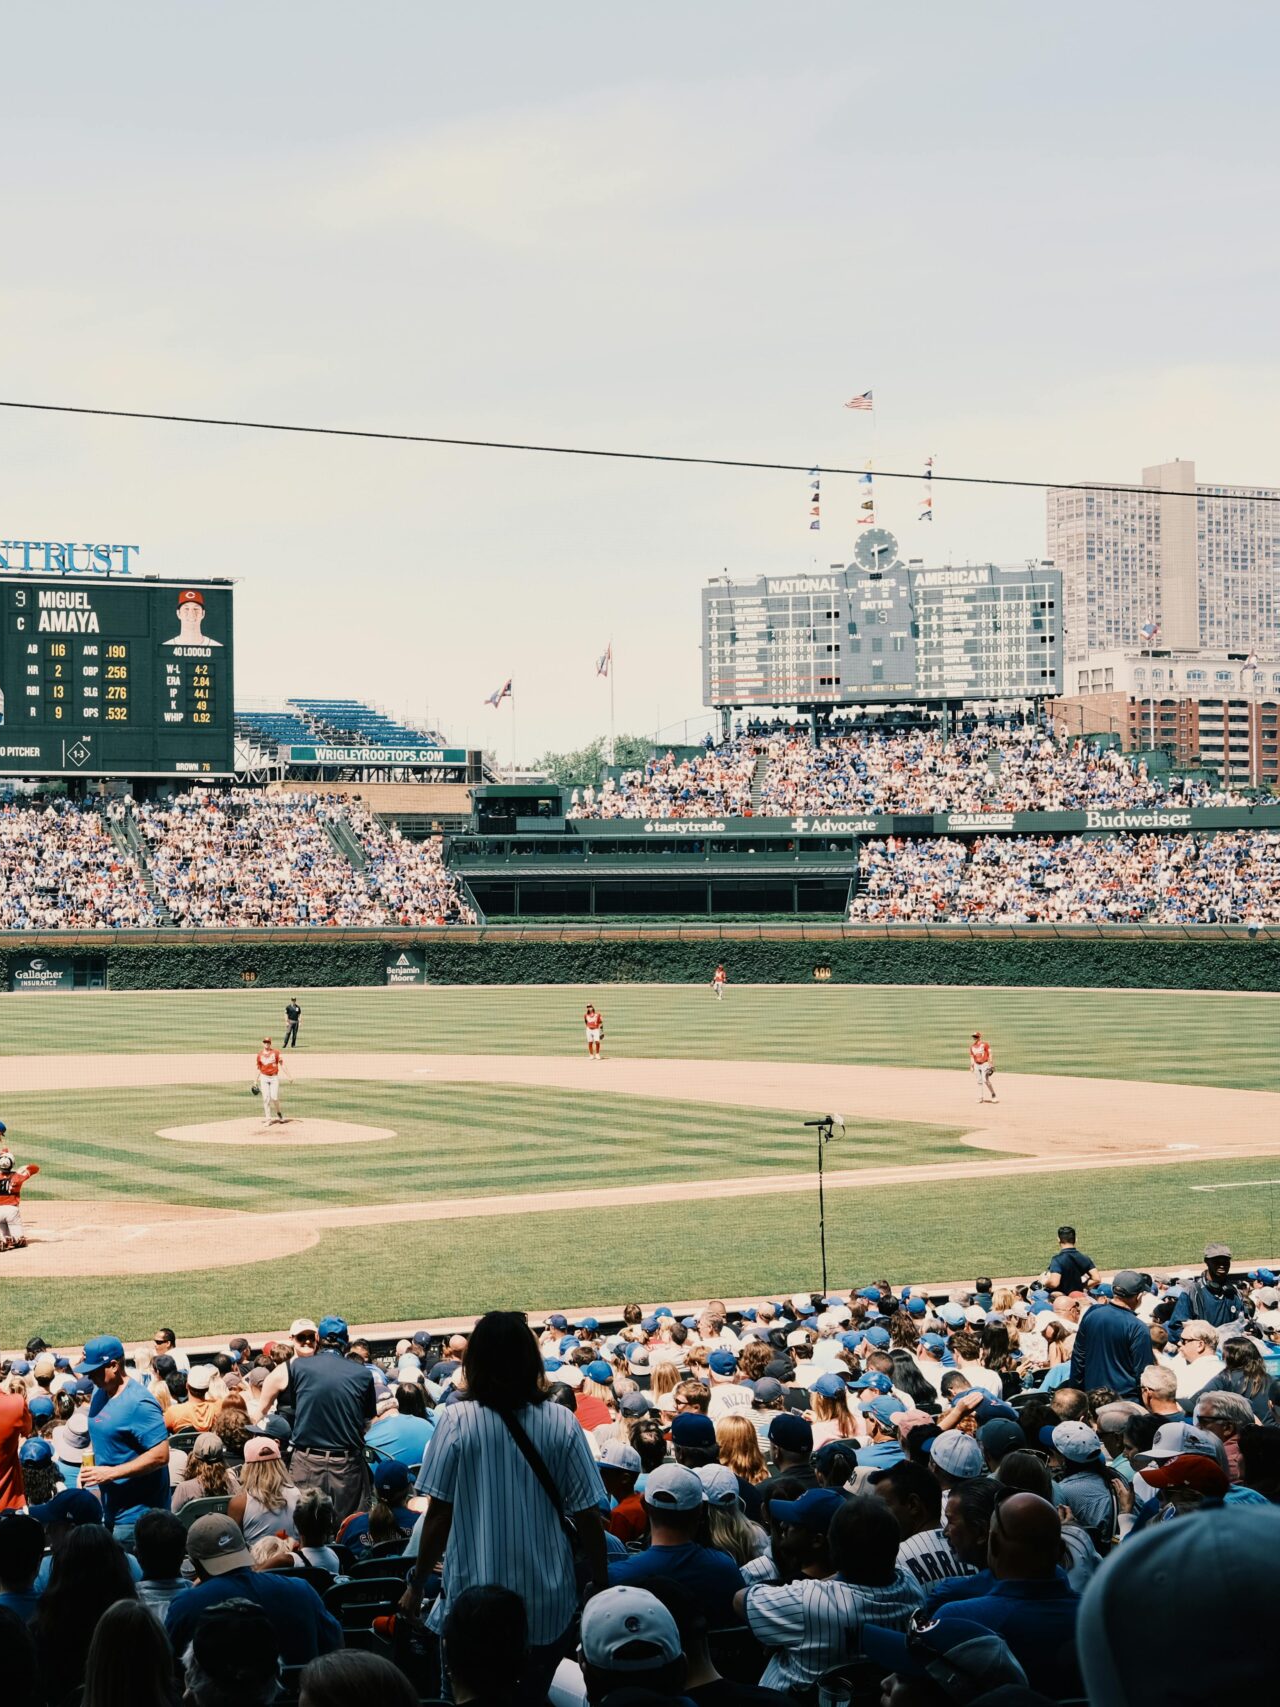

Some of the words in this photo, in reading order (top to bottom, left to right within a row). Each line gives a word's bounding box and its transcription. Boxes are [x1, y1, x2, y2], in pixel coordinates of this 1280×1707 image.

[914, 569, 988, 586] AMERICAN
[768, 578, 840, 594] NATIONAL
[15, 590, 26, 607] 9
[38, 591, 91, 609] MIGUEL
[860, 600, 893, 609] BATTER
[16, 617, 25, 630] C
[38, 610, 100, 633] AMAYA
[878, 610, 888, 624] 9
[27, 644, 38, 654] AB
[51, 644, 66, 656] 116
[83, 646, 98, 656] AVG
[105, 646, 126, 658] .190
[173, 647, 183, 657] 40
[183, 647, 211, 657] LODOLO
[27, 665, 39, 675] HR
[55, 665, 62, 677] 2
[83, 666, 99, 676] OBP
[105, 666, 127, 678] .256
[166, 664, 181, 674] W-L
[195, 665, 208, 675] 4-2
[166, 676, 181, 686] ERA
[193, 676, 210, 687] 2.84
[26, 686, 40, 696] RBI
[53, 685, 64, 698] 13
[83, 687, 98, 697] SLG
[105, 686, 127, 699] .276
[170, 688, 178, 698] IP
[194, 689, 209, 699] 44.1
[171, 700, 177, 710] K
[196, 701, 207, 710] 49
[30, 707, 36, 717] R
[55, 706, 62, 719] 9
[83, 708, 99, 718] OPS
[105, 707, 127, 720] .532
[164, 712, 183, 722] WHIP
[193, 713, 210, 723] 0.92
[7, 747, 40, 758] PITCHER
[315, 748, 444, 762] WRIGLEYROOFTOPS.COM
[176, 763, 198, 771] BROWN
[811, 819, 877, 832] Advocate
[947, 814, 1015, 825] GRAINGER
[1086, 811, 1191, 828] Budweiser
[654, 821, 726, 834] tastytrade
[15, 970, 64, 980] Gallagher
[386, 966, 420, 976] Benjamin
[814, 967, 831, 978] 400
